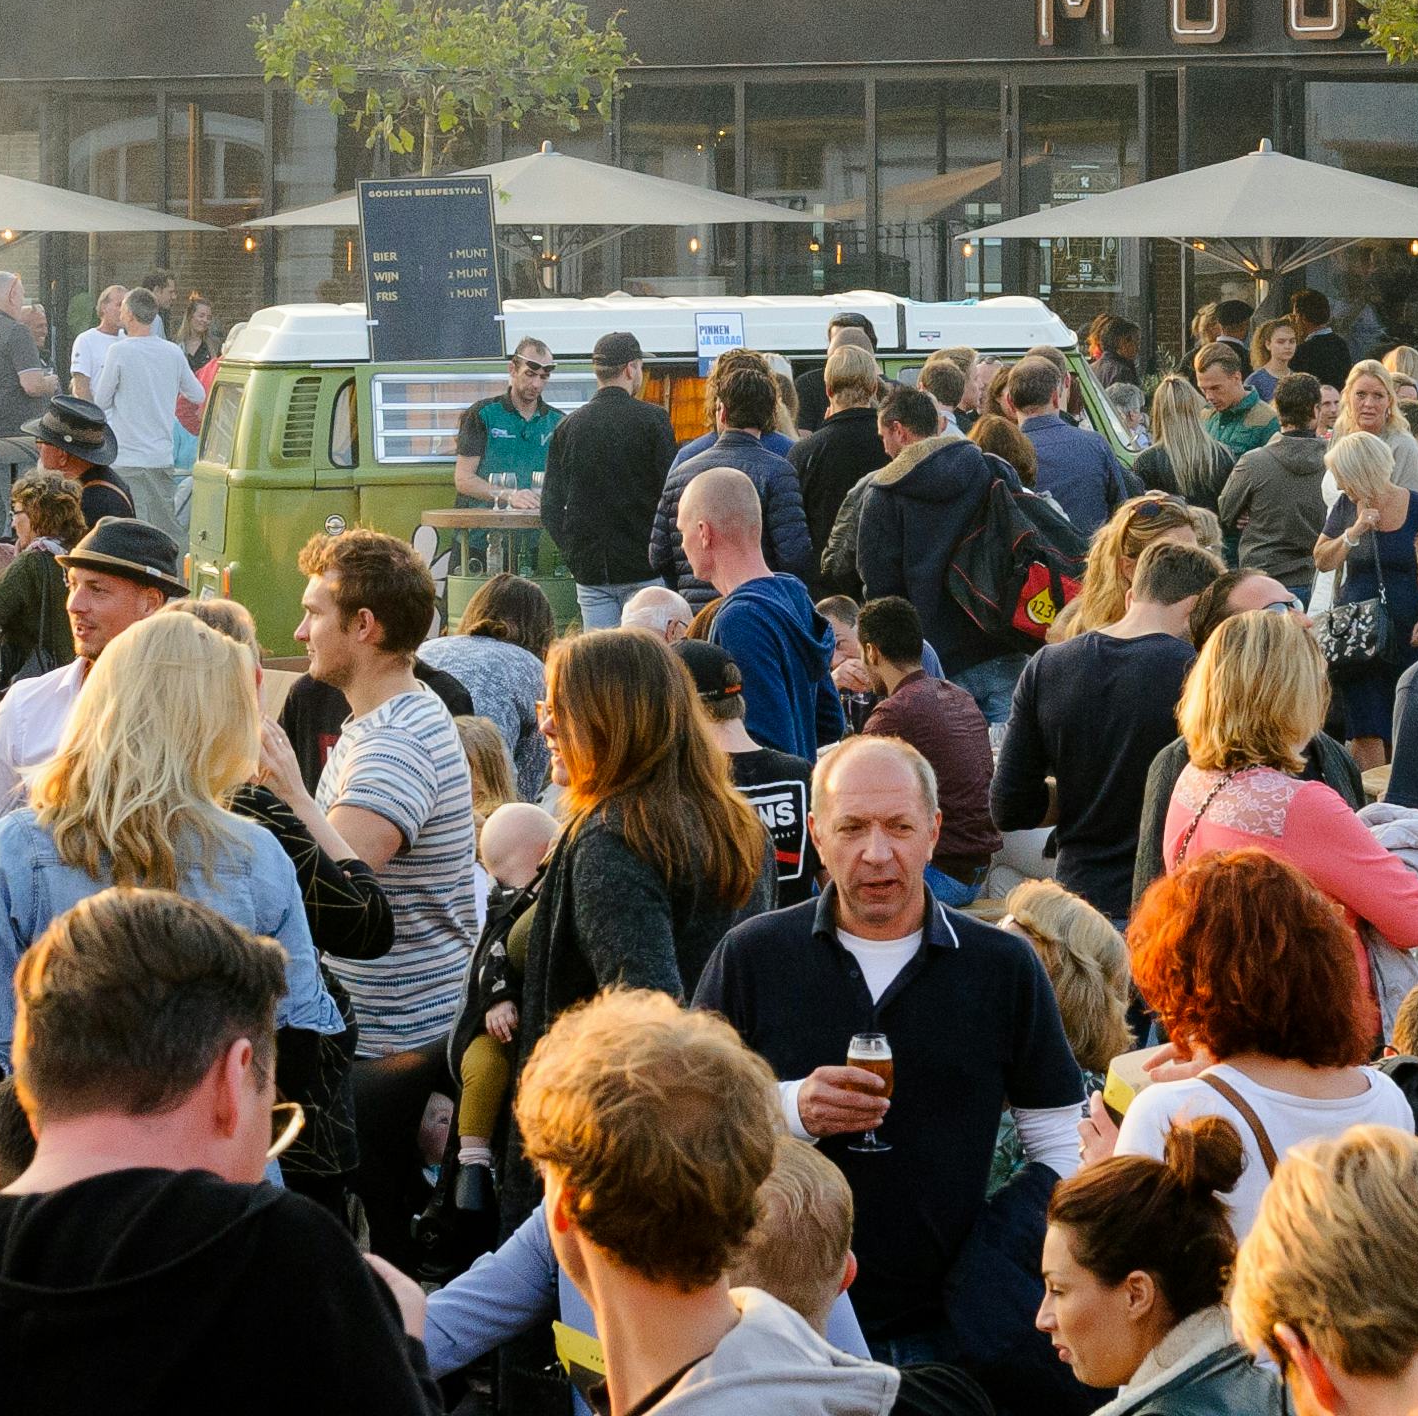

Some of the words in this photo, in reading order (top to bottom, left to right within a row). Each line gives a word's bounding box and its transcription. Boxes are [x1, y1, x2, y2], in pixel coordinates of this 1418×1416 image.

[368, 189, 412, 198] GOOISCH
[414, 187, 483, 197] BIERFESTIVAL
[373, 251, 398, 262] BIER
[456, 248, 488, 260] MUNT
[373, 271, 399, 283] WIJN
[448, 271, 454, 279] 2
[456, 268, 488, 279] MUNT
[375, 290, 398, 302] FRIS
[456, 287, 489, 298] MUNT
[698, 324, 730, 335] PINNEN
[700, 335, 711, 345] JA
[713, 335, 742, 345] GRAAG
